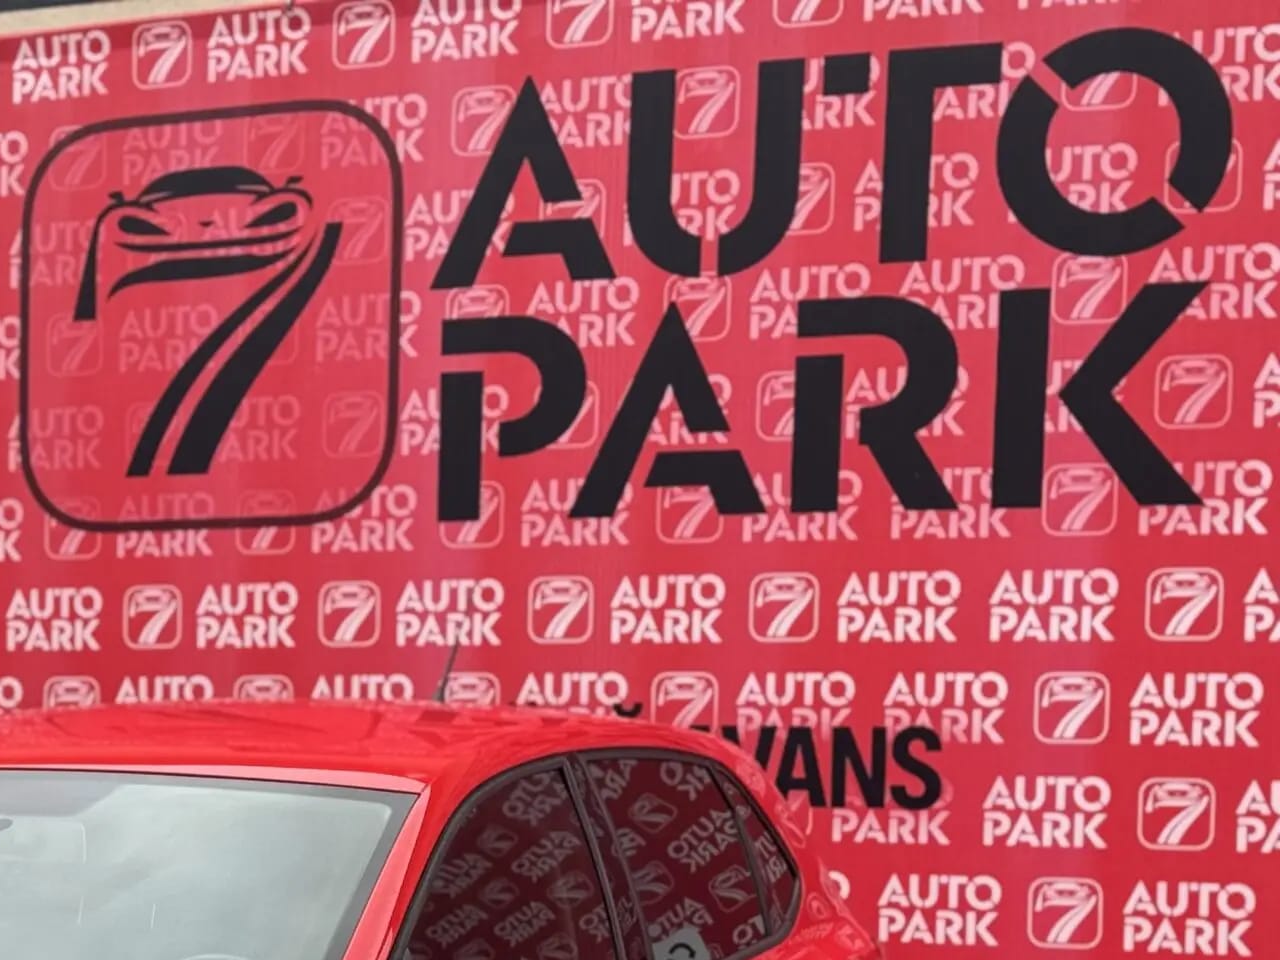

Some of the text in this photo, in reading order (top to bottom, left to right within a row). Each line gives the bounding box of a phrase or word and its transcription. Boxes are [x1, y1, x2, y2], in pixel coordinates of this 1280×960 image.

[208, 6, 311, 48] AUTO
[412, 22, 518, 63] PARK
[631, 5, 745, 43] PARK
[13, 29, 111, 70] AUTO
[208, 39, 308, 82] PARK
[13, 62, 108, 104] PARK
[430, 27, 1233, 289] AUTO
[900, 255, 1026, 294] AUTO
[1148, 242, 1279, 284] AUTO
[527, 277, 640, 314] AUTO
[750, 263, 870, 302] AUTO
[437, 281, 1211, 522] PARK
[311, 520, 414, 554] PARK
[6, 587, 102, 620] AUTO
[197, 582, 298, 616] AUTO
[396, 578, 504, 613] AUTO
[611, 574, 725, 609] AUTO
[838, 571, 960, 607] AUTO
[990, 569, 1118, 605] AUTO
[7, 618, 100, 651] PARK
[197, 614, 294, 648] PARK
[396, 611, 500, 646] PARK
[611, 608, 721, 643] PARK
[838, 606, 956, 642] PARK
[990, 604, 1114, 642] PARK
[517, 672, 629, 707] AUTO
[737, 671, 856, 708] AUTO
[883, 671, 1008, 708] AUTO
[1130, 673, 1263, 710] AUTO
[1130, 708, 1258, 747] PARK
[983, 776, 1111, 812] AUTO
[832, 810, 951, 846] PARK
[983, 811, 1106, 848] PARK
[878, 874, 1001, 910] AUTO
[1123, 881, 1256, 919] AUTO
[878, 907, 997, 946] PARK
[1123, 916, 1251, 956] PARK
